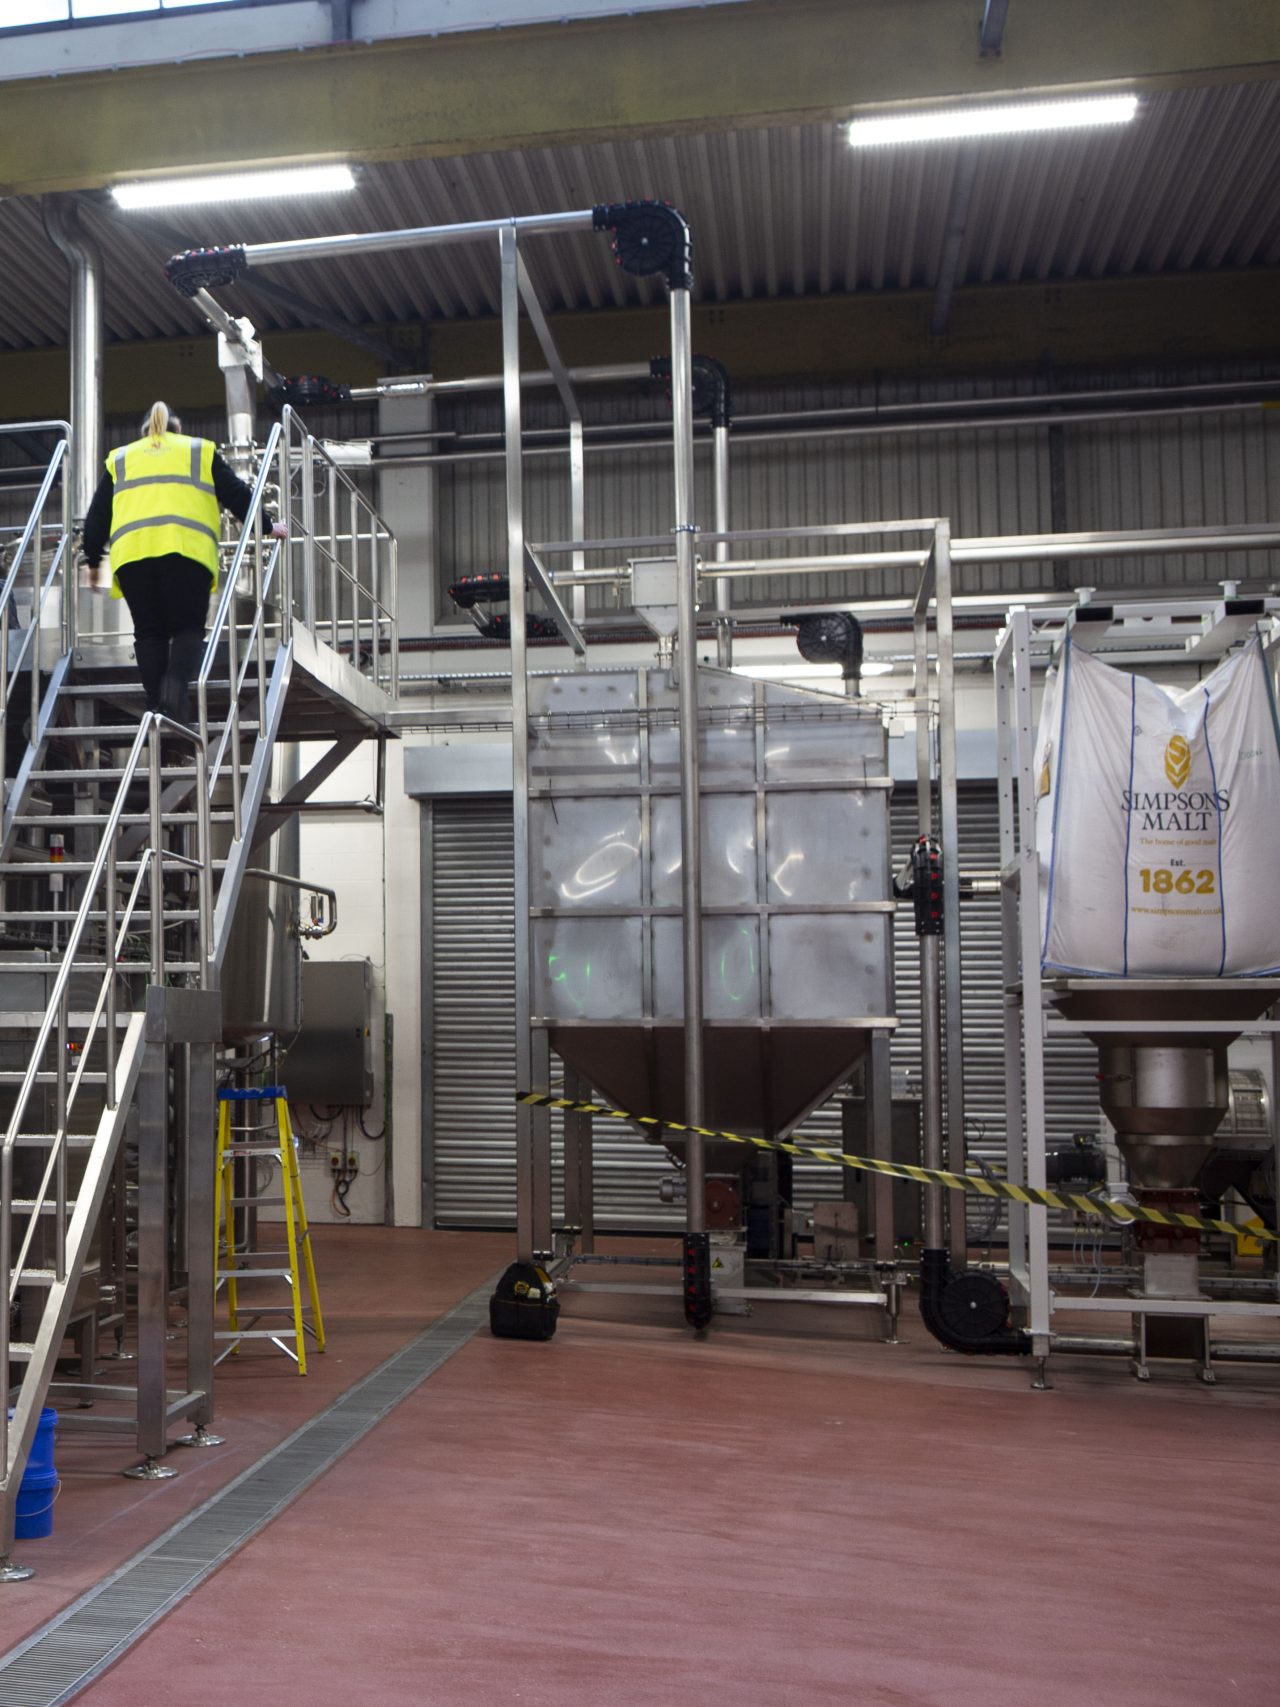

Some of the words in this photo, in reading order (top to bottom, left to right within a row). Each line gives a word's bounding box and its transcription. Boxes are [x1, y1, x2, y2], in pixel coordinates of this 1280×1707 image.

[1121, 789, 1231, 812] SIMPSONS
[1142, 812, 1213, 831] MALT
[1140, 837, 1153, 845] The
[1155, 837, 1174, 845] home
[1176, 837, 1183, 845] of
[1184, 838, 1201, 847] good
[1170, 858, 1186, 867] Est.
[1139, 868, 1215, 894] 1862
